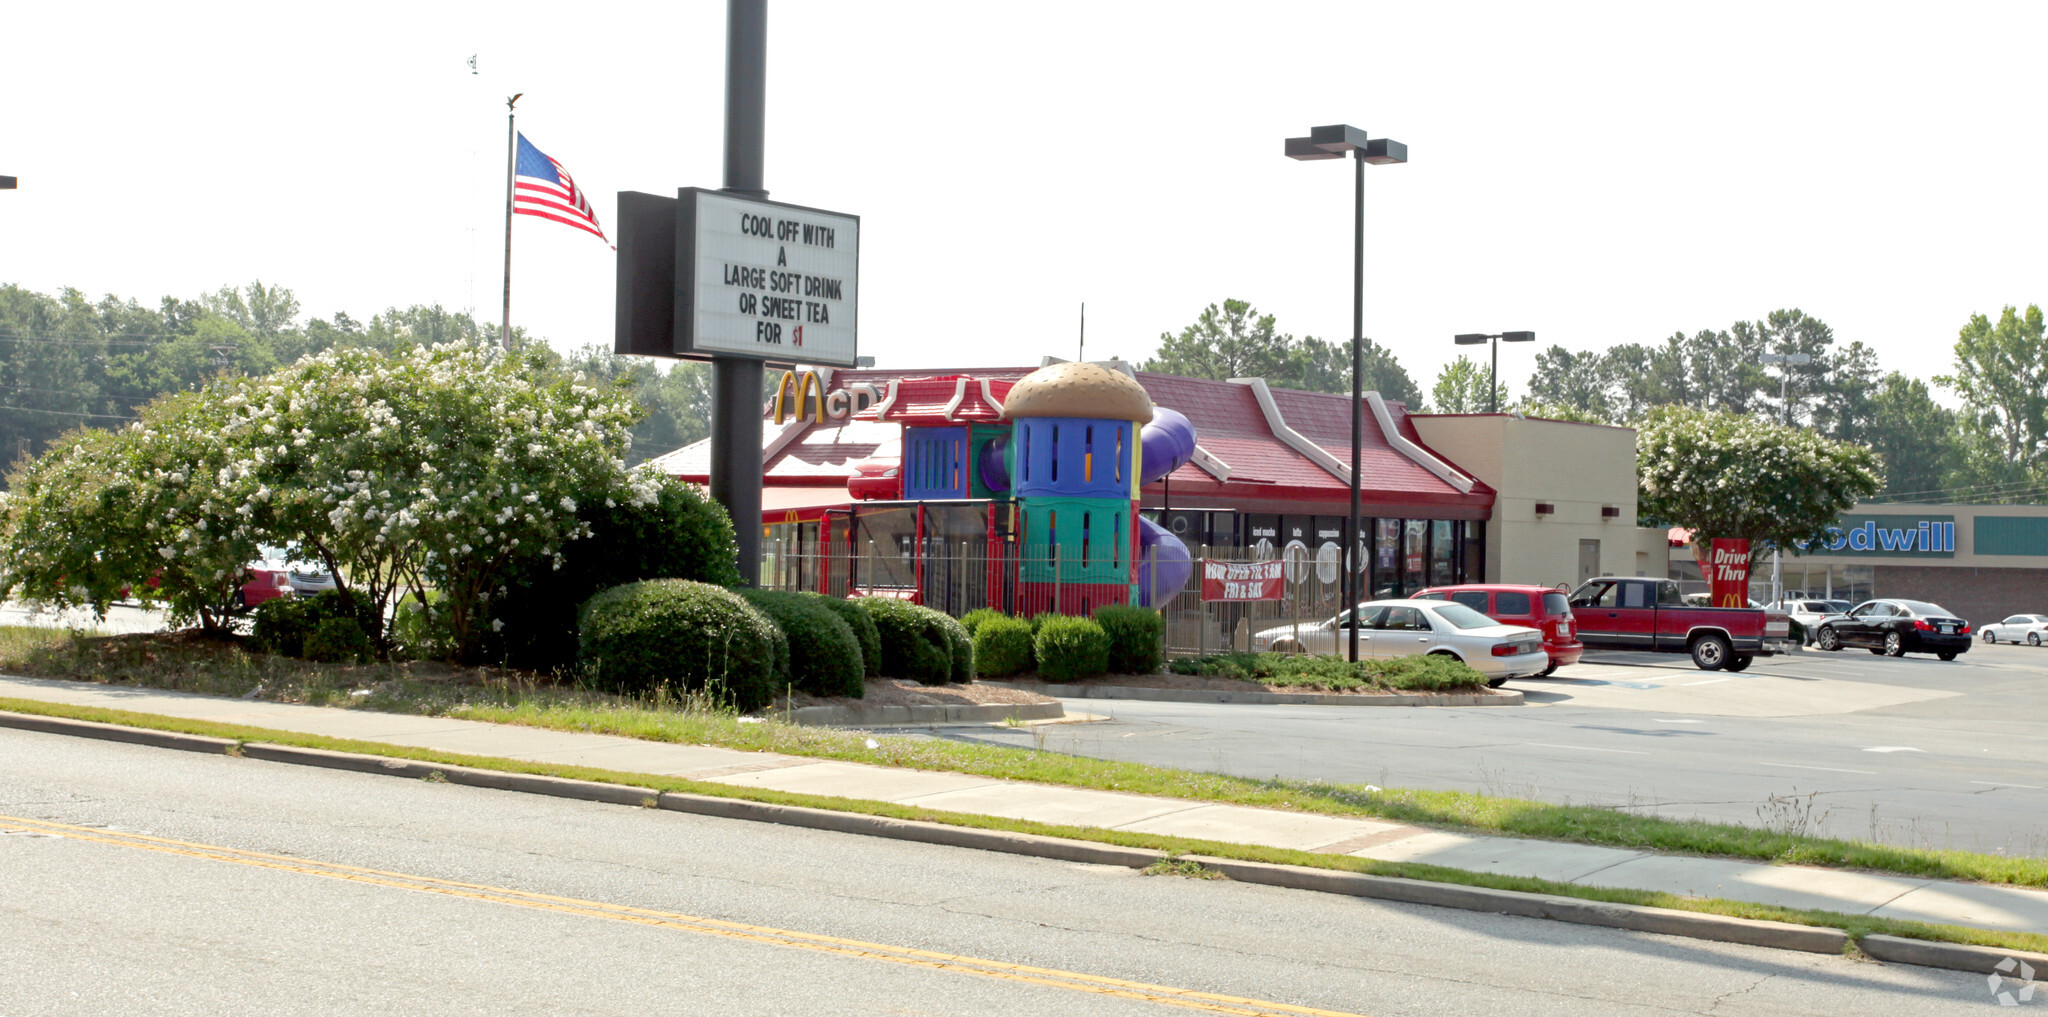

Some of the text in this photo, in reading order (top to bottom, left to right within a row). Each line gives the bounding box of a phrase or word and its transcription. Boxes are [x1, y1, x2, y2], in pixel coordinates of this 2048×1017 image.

[742, 213, 835, 249] COOL OFF WITH
[777, 246, 787, 267] A
[724, 263, 842, 301] LARGE SOFT DRINK
[739, 292, 829, 324] OR SWEET TEA
[757, 321, 803, 347] FOR $1
[1714, 548, 1747, 565] Drive
[1205, 562, 1227, 580] NOW
[1227, 565, 1250, 580] OPEN
[1264, 564, 1269, 579] 1
[1268, 562, 1282, 579] AM
[1717, 564, 1746, 581] Thru
[1223, 581, 1263, 599] FRI & SAT
